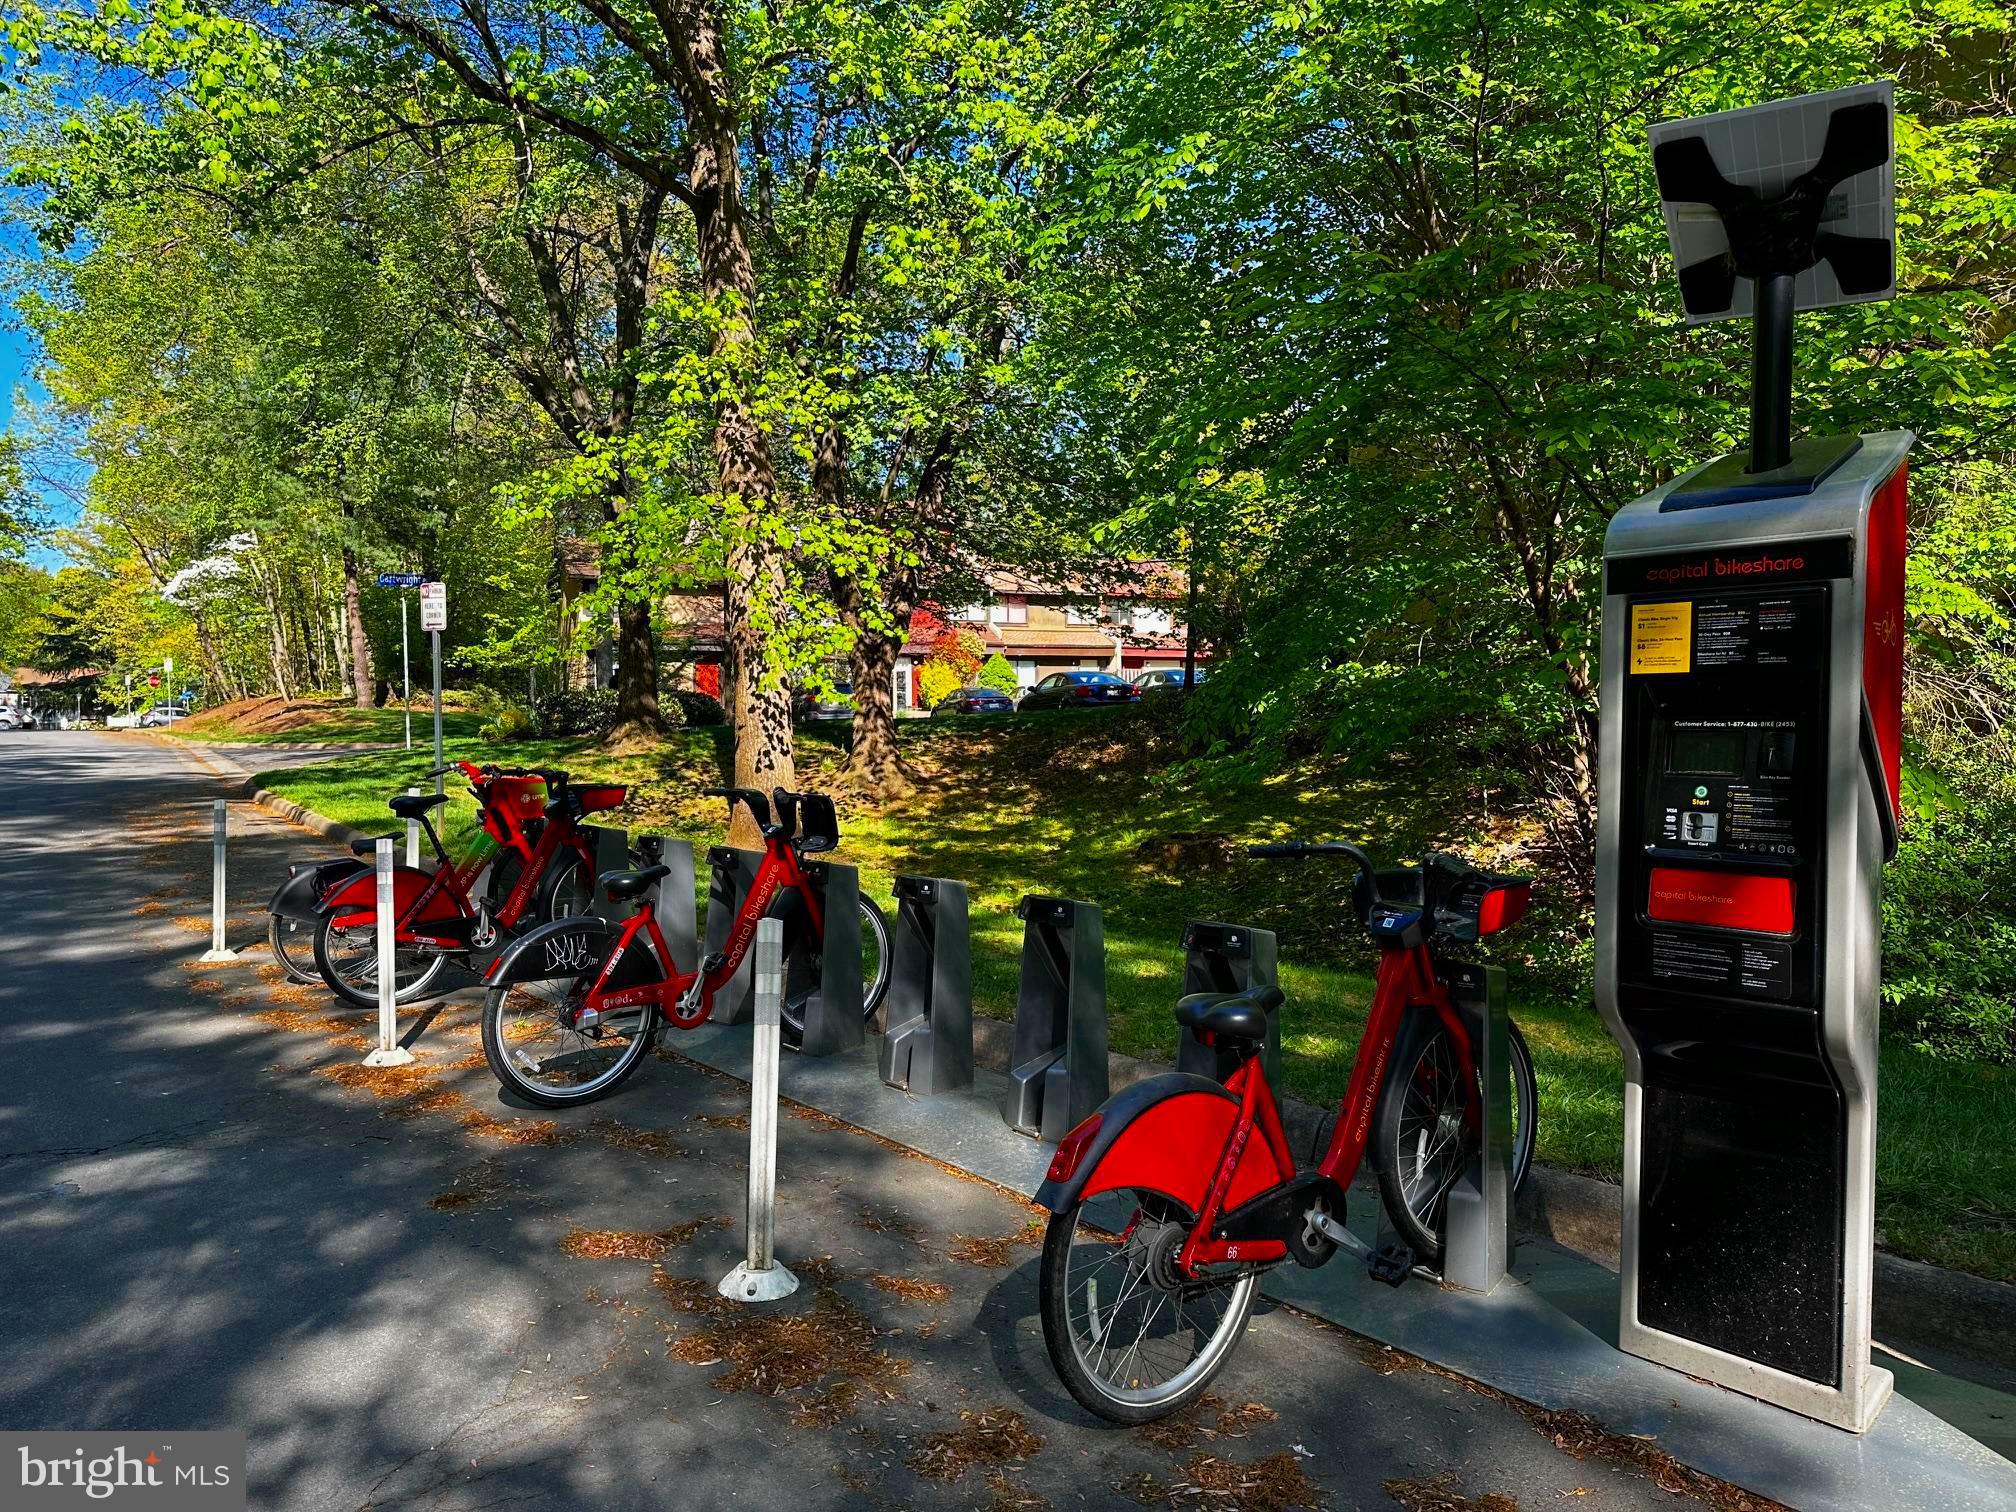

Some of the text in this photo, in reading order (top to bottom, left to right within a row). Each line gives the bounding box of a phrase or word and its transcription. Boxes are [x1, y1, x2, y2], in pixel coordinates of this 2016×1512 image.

[1647, 556, 1804, 583] capital bikeshare
[1692, 798, 1710, 806] Start
[471, 856, 483, 873] now
[1654, 890, 1734, 904] capital bikeshare
[728, 864, 779, 968] capital bikeshare
